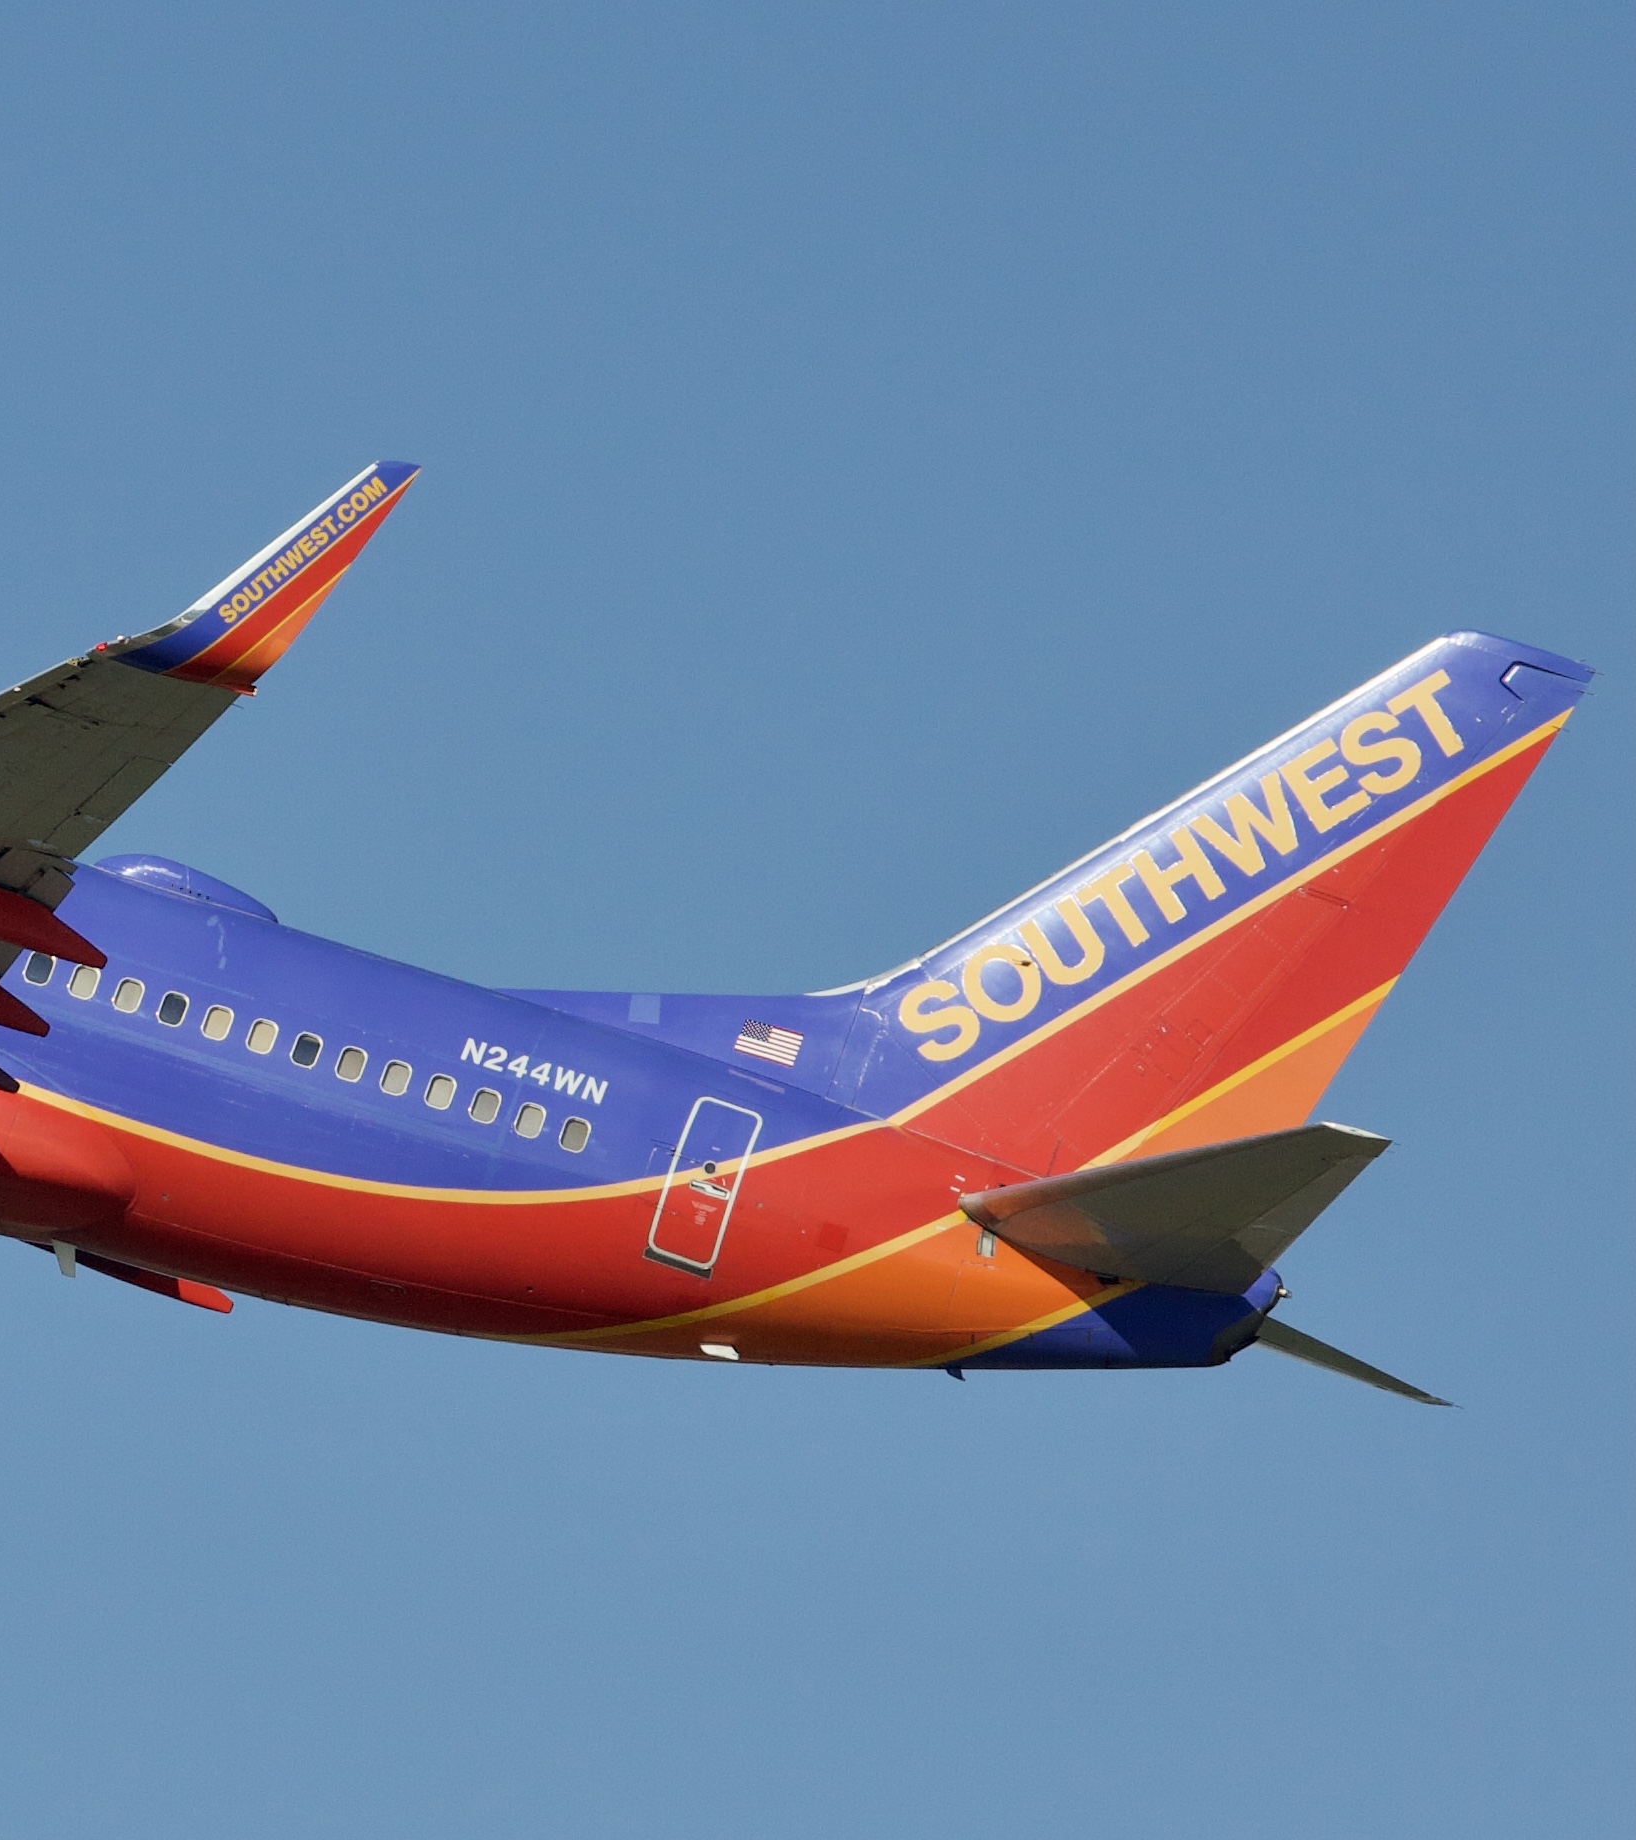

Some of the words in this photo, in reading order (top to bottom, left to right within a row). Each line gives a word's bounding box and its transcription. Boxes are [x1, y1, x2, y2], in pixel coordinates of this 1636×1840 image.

[218, 476, 388, 624] SOUTHWEST.COM
[899, 668, 1465, 1062] SOUTHWEST
[460, 1037, 609, 1105] N244WN
